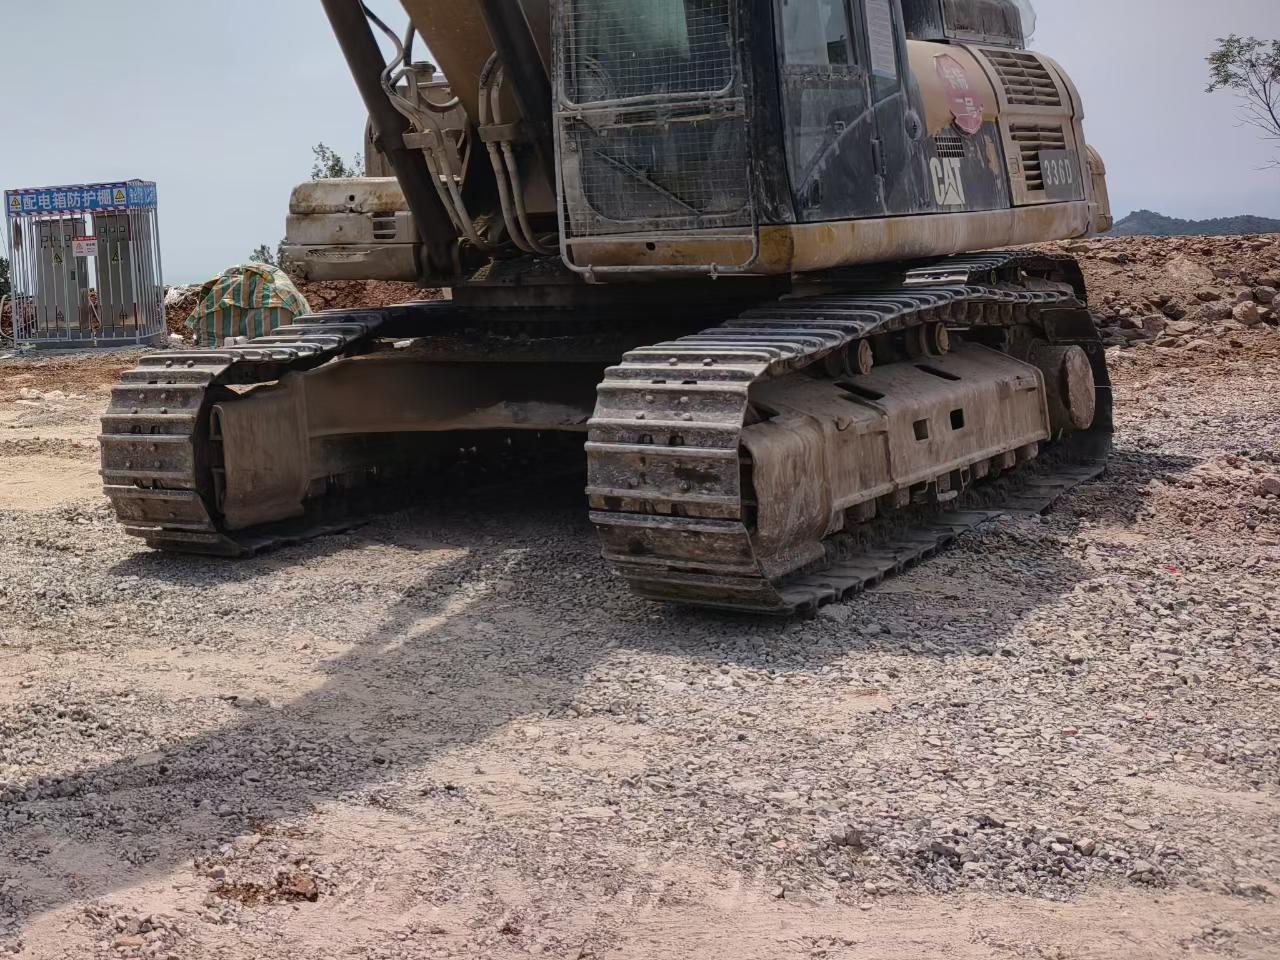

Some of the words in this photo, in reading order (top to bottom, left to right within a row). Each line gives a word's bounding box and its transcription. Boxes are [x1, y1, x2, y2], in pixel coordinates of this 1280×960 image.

[930, 157, 966, 205] CAT
[1044, 159, 1073, 185] 336D
[22, 190, 111, 210] 配电箱防护棚
